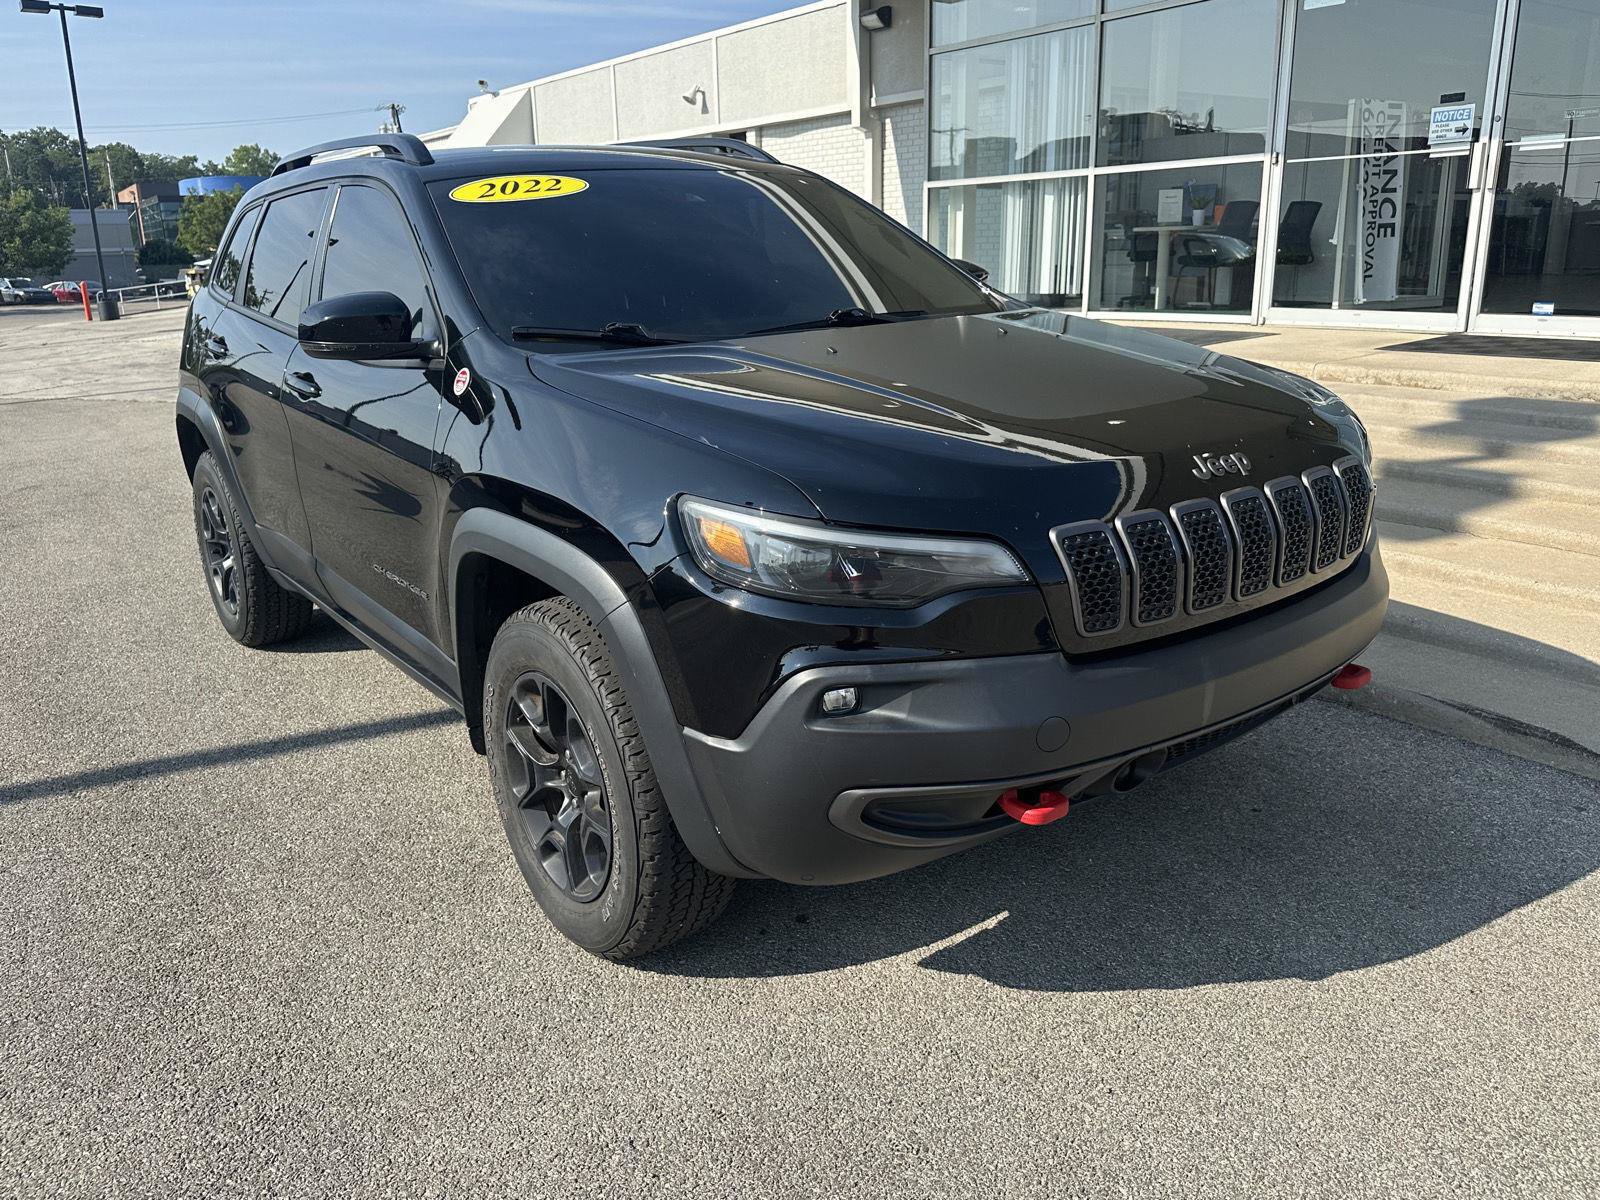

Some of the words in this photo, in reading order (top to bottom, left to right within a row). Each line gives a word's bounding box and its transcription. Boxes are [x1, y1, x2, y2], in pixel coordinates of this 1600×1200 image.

[1435, 110, 1470, 122] NOTICE
[1371, 110, 1386, 179] CREDIT
[477, 179, 562, 199] 2022
[1363, 184, 1379, 283] APPROVAL
[1192, 452, 1251, 479] Jeep
[373, 564, 429, 600] CHEROKEE
